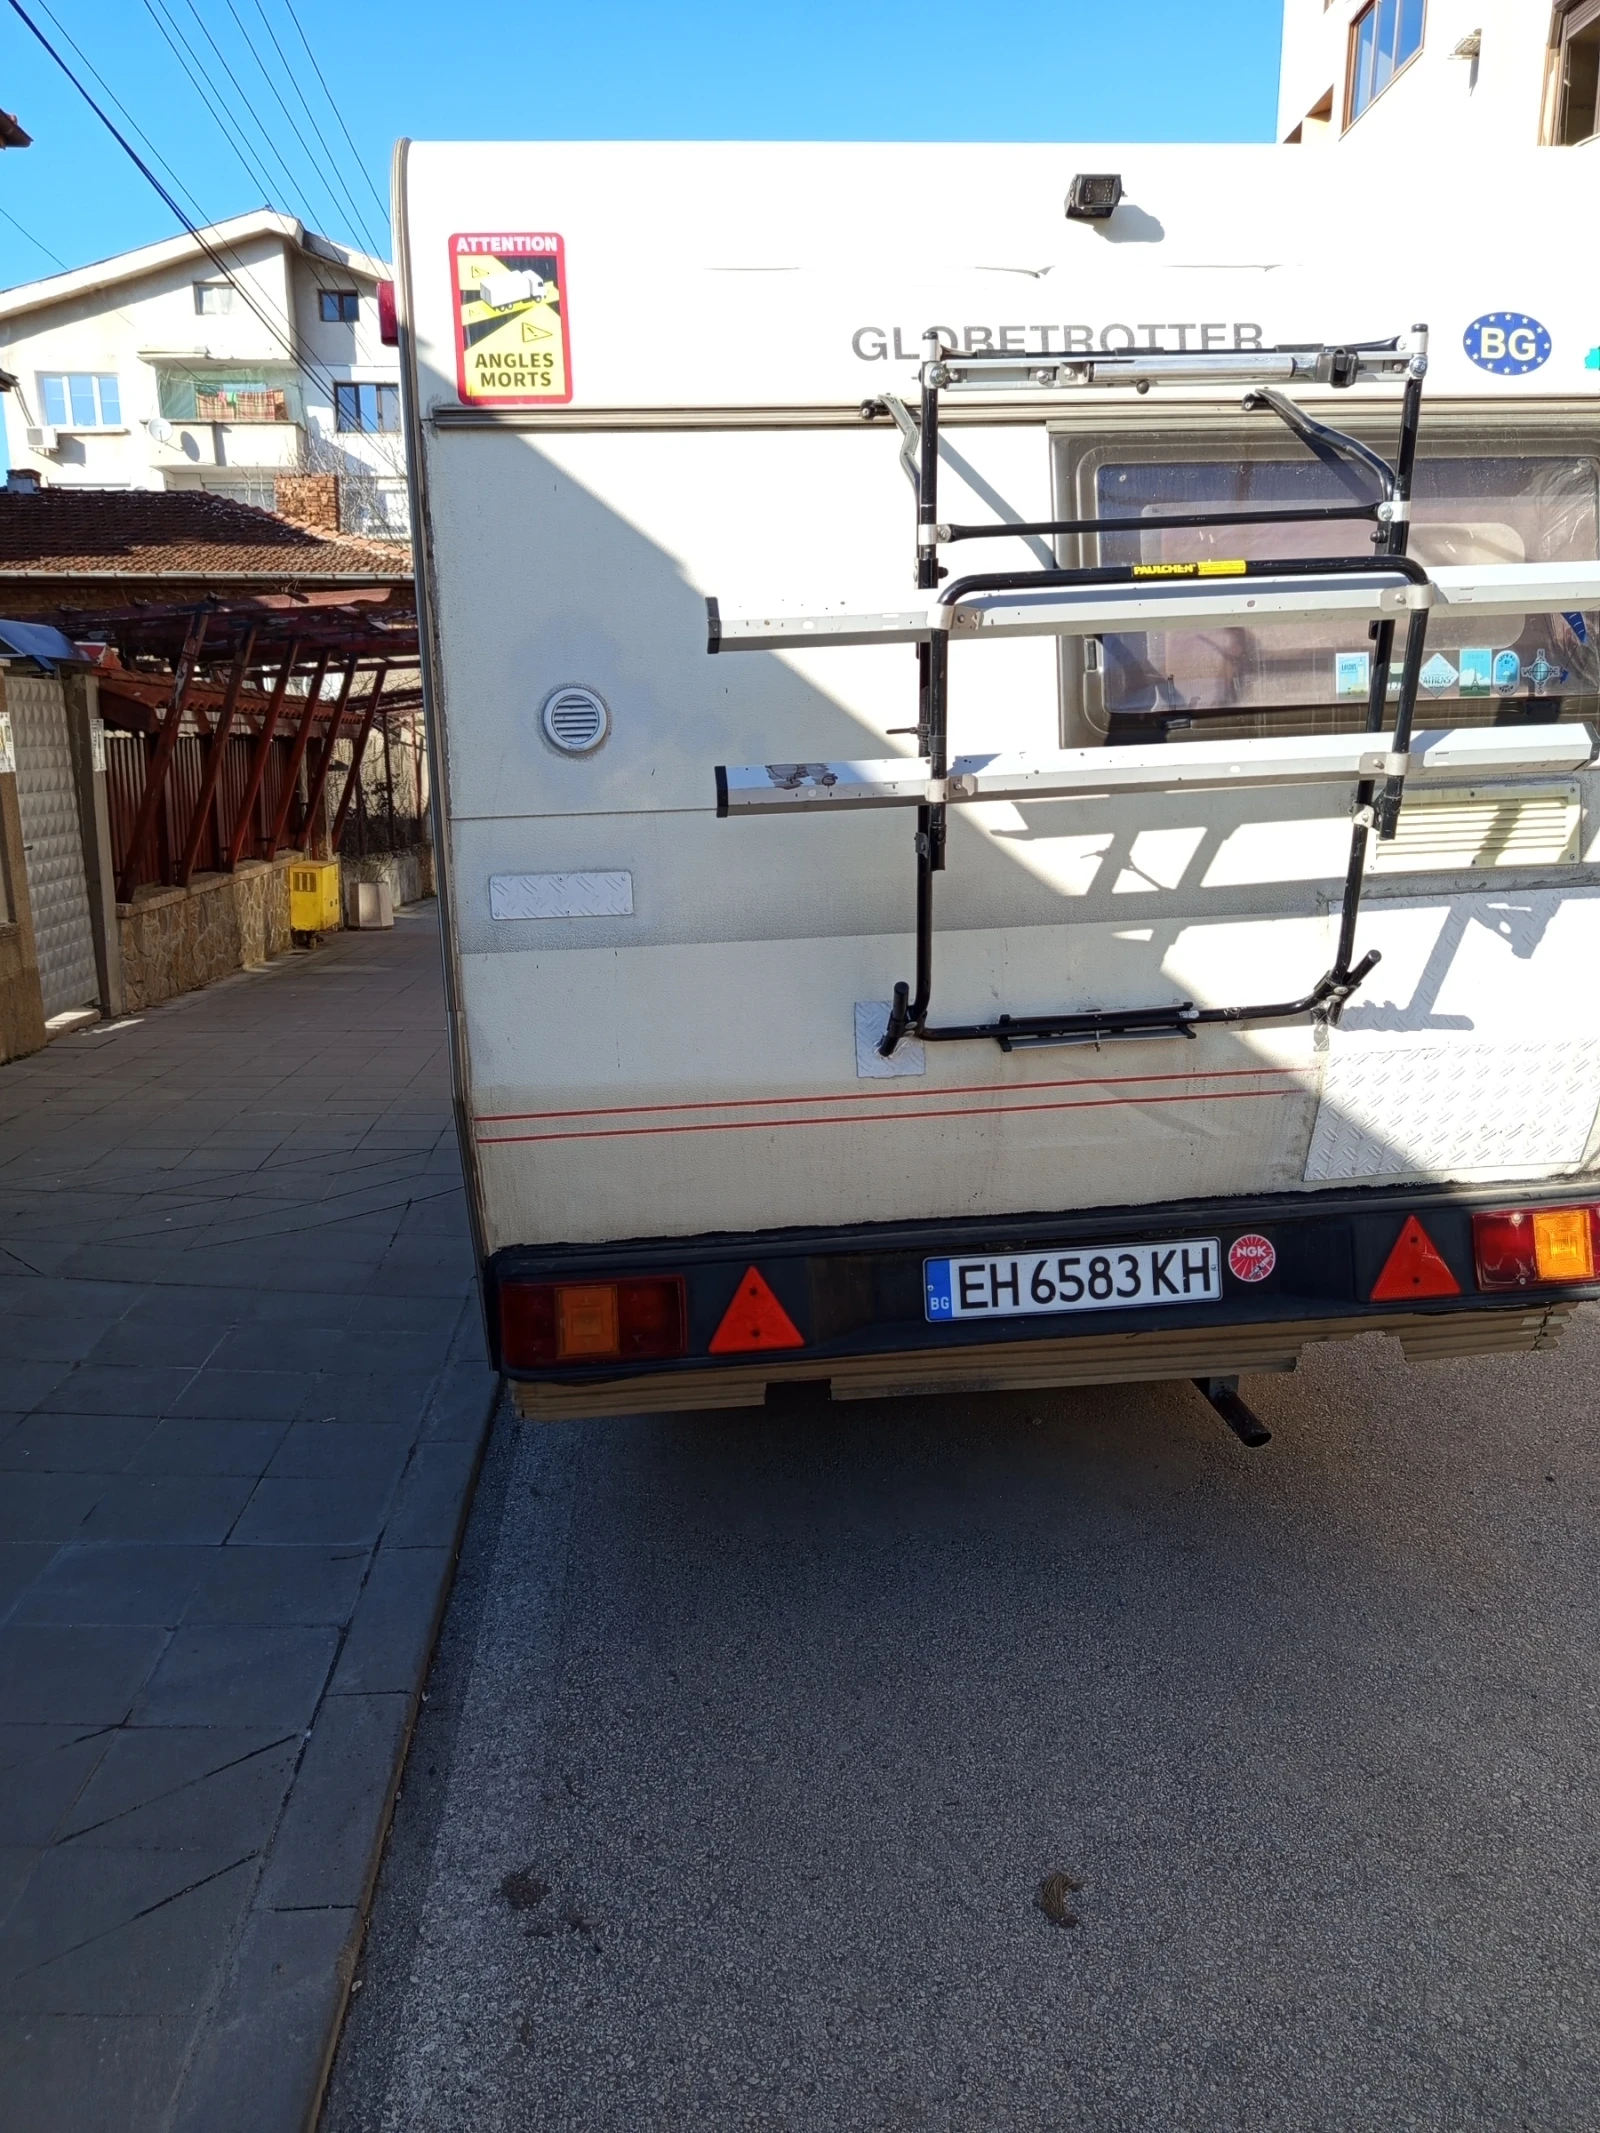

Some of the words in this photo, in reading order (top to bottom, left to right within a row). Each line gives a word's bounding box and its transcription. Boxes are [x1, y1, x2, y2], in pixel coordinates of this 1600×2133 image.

[456, 236, 558, 252] ATTENTION
[851, 323, 1263, 361] GLOBETROTTER
[1480, 327, 1536, 361] BG
[475, 352, 554, 369] ANGLES
[481, 371, 552, 388] MORTS
[1422, 675, 1452, 684] ATHENS
[1236, 1245, 1267, 1258] NGK
[958, 1262, 1020, 1310] EH
[1030, 1253, 1142, 1304] 6583
[1151, 1247, 1212, 1296] KH
[930, 1297, 950, 1311] BG
